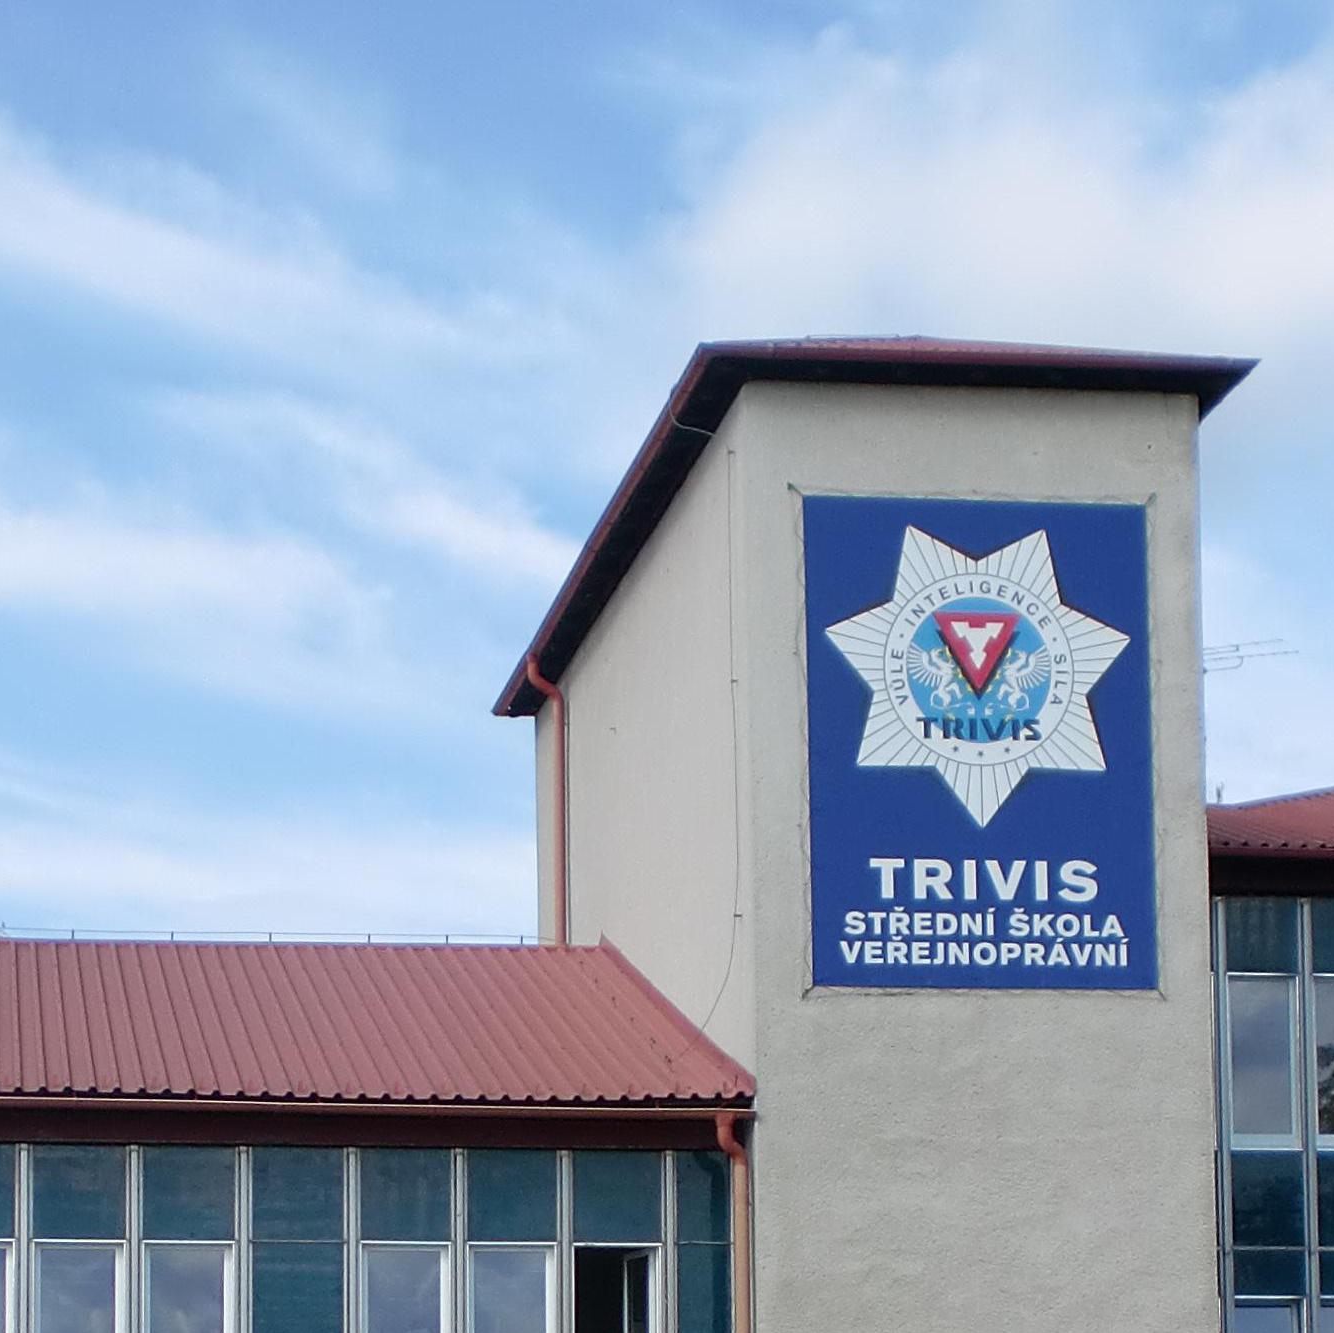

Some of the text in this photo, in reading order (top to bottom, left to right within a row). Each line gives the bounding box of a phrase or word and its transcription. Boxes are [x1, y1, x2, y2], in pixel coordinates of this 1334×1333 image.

[905, 580, 1052, 630] INTELIGENCE
[915, 715, 1043, 742] TRIVIS
[869, 857, 1100, 902] TRIVIS
[843, 905, 1125, 938] STŘEDNÍ ŠKOLA
[839, 935, 1130, 967] VEŘEJNOPRÁVNÍ
